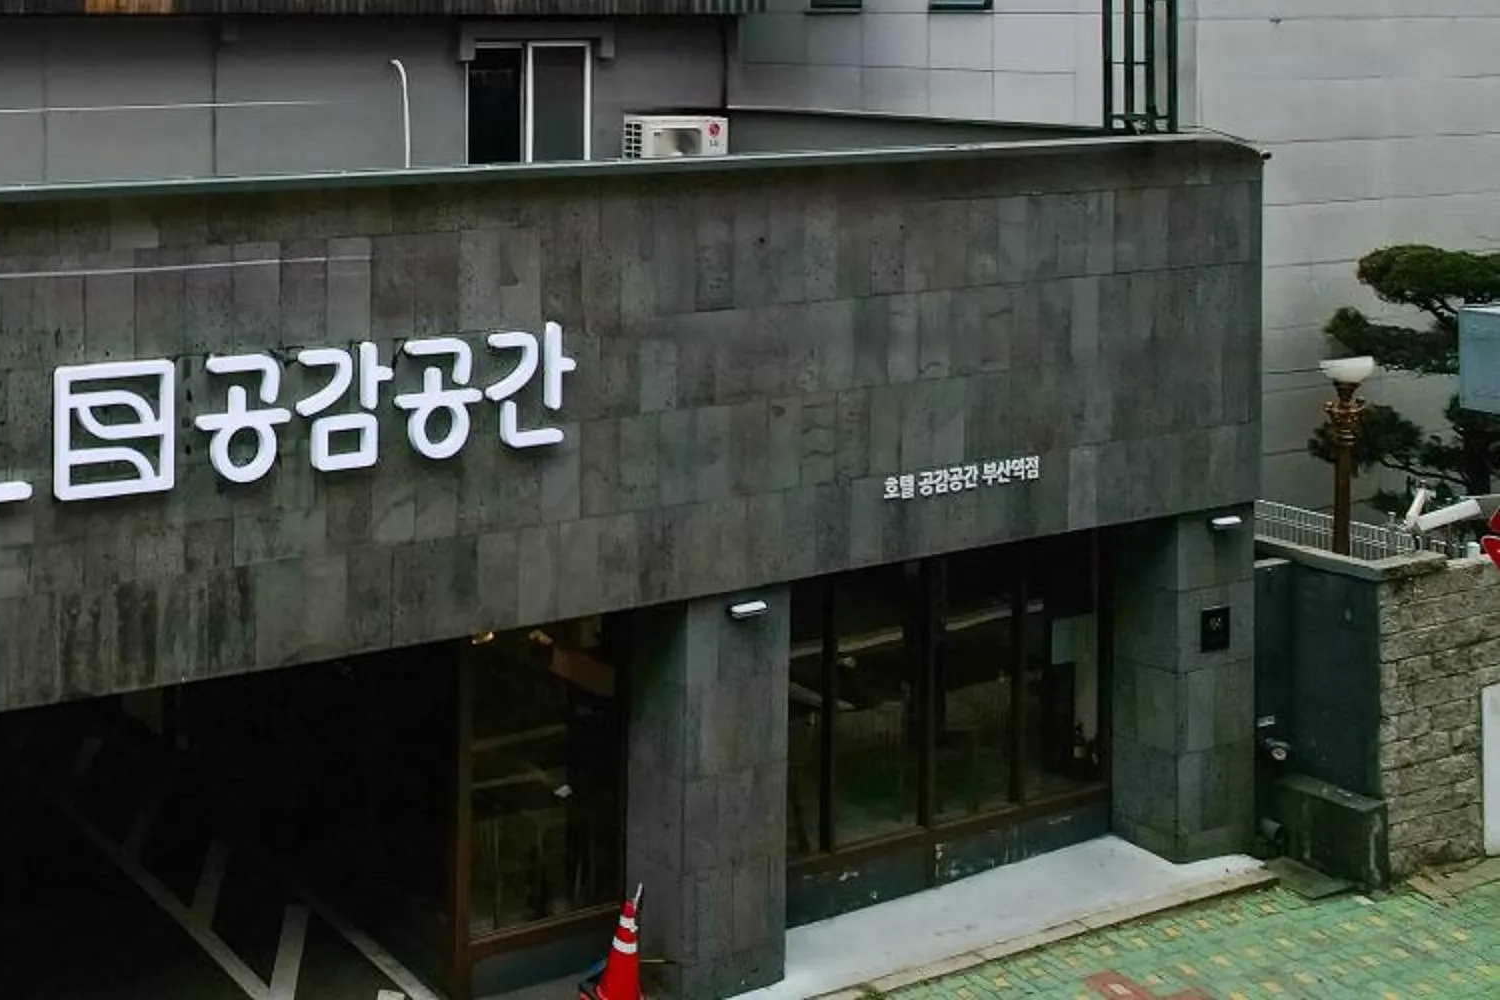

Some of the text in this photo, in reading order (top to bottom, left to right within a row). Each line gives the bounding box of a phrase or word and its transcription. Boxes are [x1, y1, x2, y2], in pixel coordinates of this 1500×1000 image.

[195, 321, 577, 483] 공감공간
[883, 455, 1040, 499] 호텔 공감공간 부산역점
